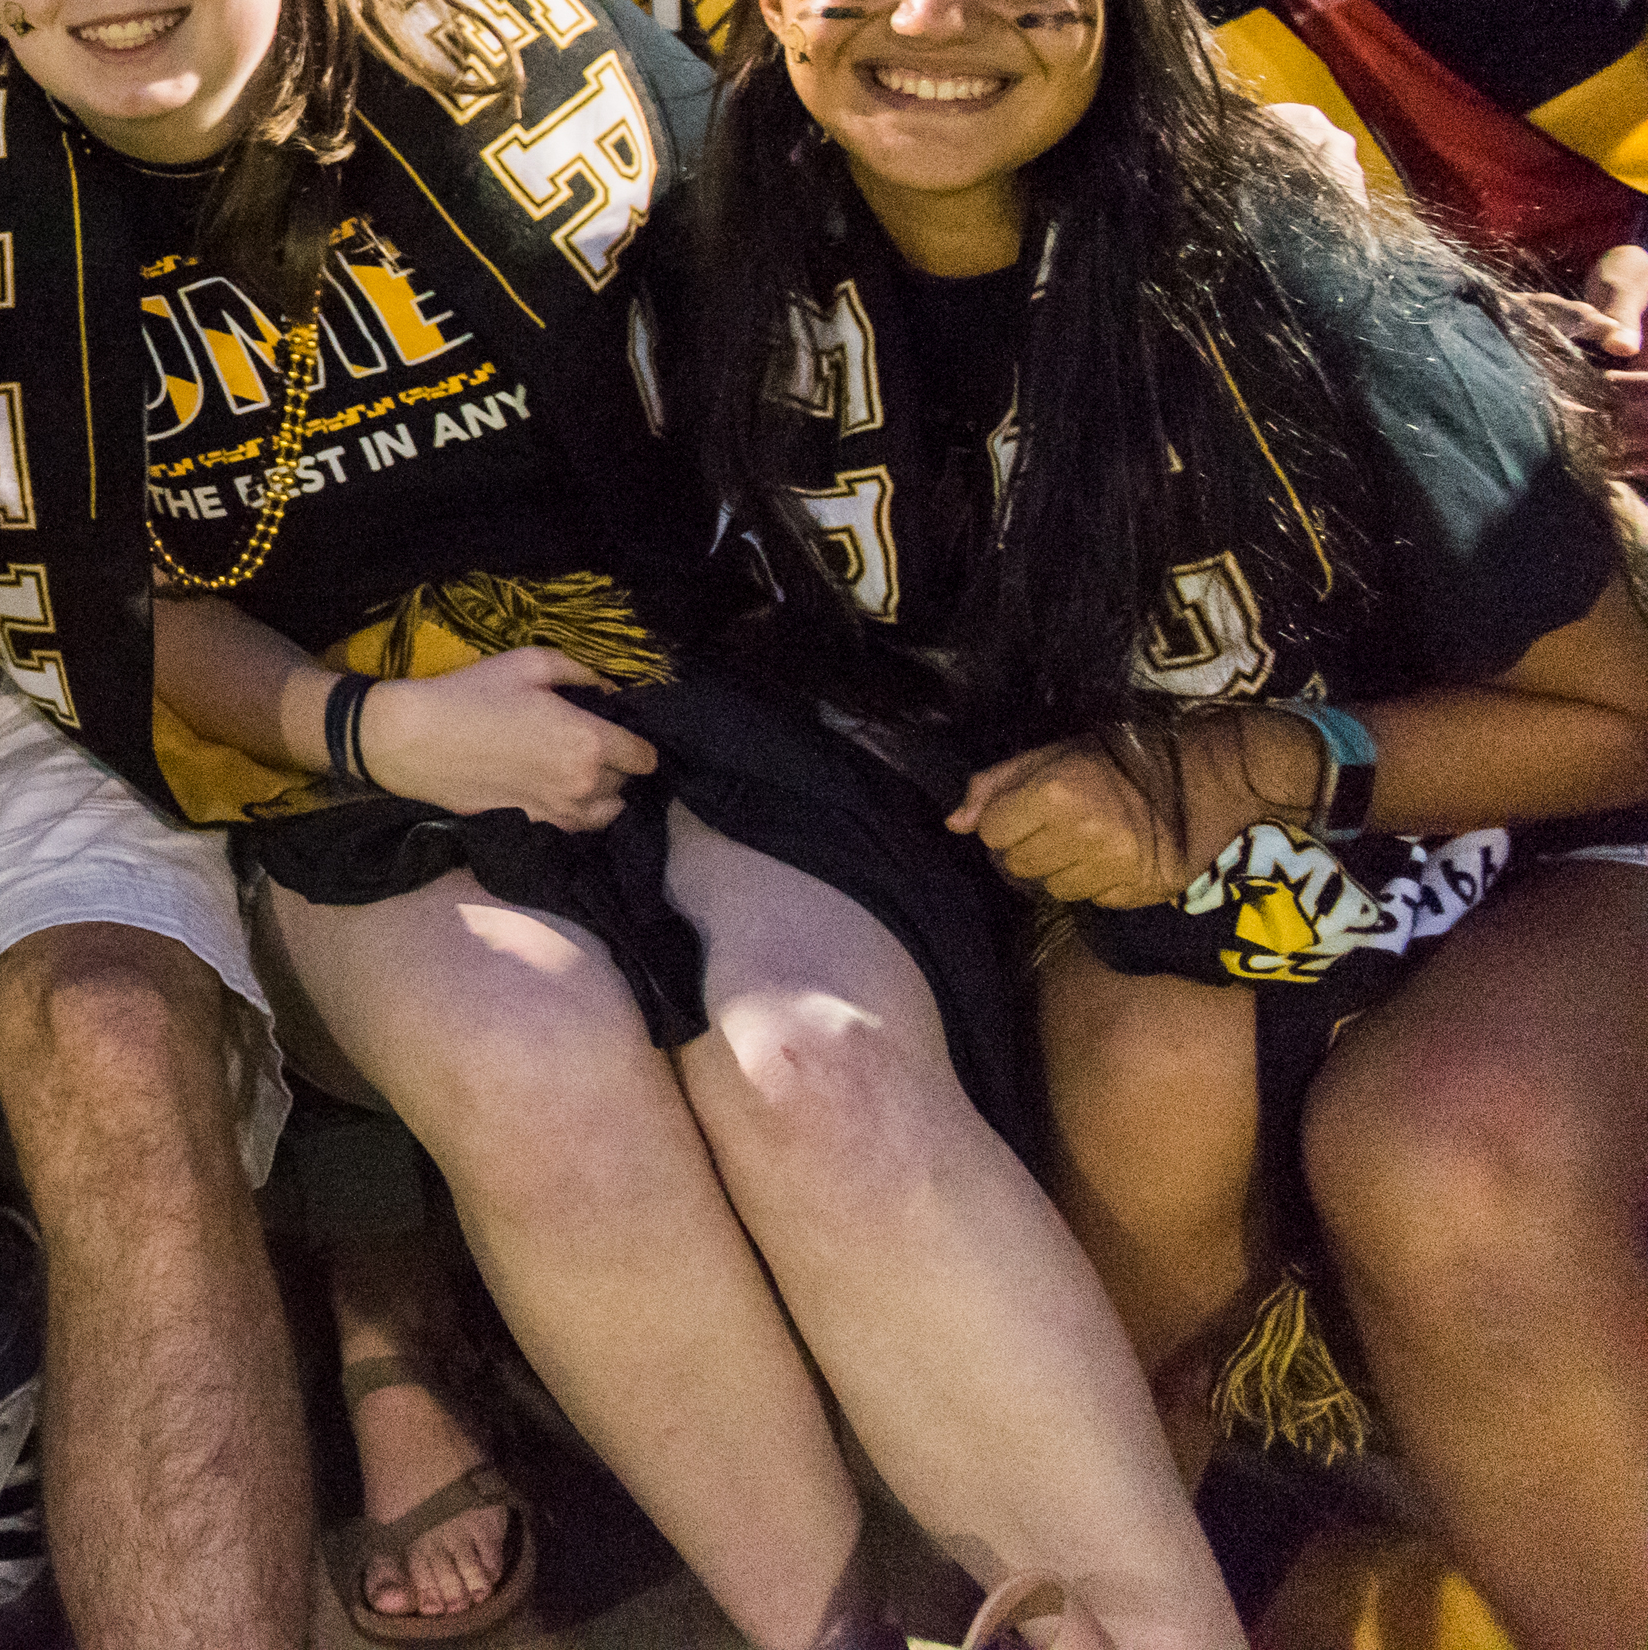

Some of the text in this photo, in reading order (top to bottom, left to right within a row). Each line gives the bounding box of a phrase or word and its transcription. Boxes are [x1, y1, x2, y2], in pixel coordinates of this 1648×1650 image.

[148, 384, 531, 521] THE BEST IN ANY
